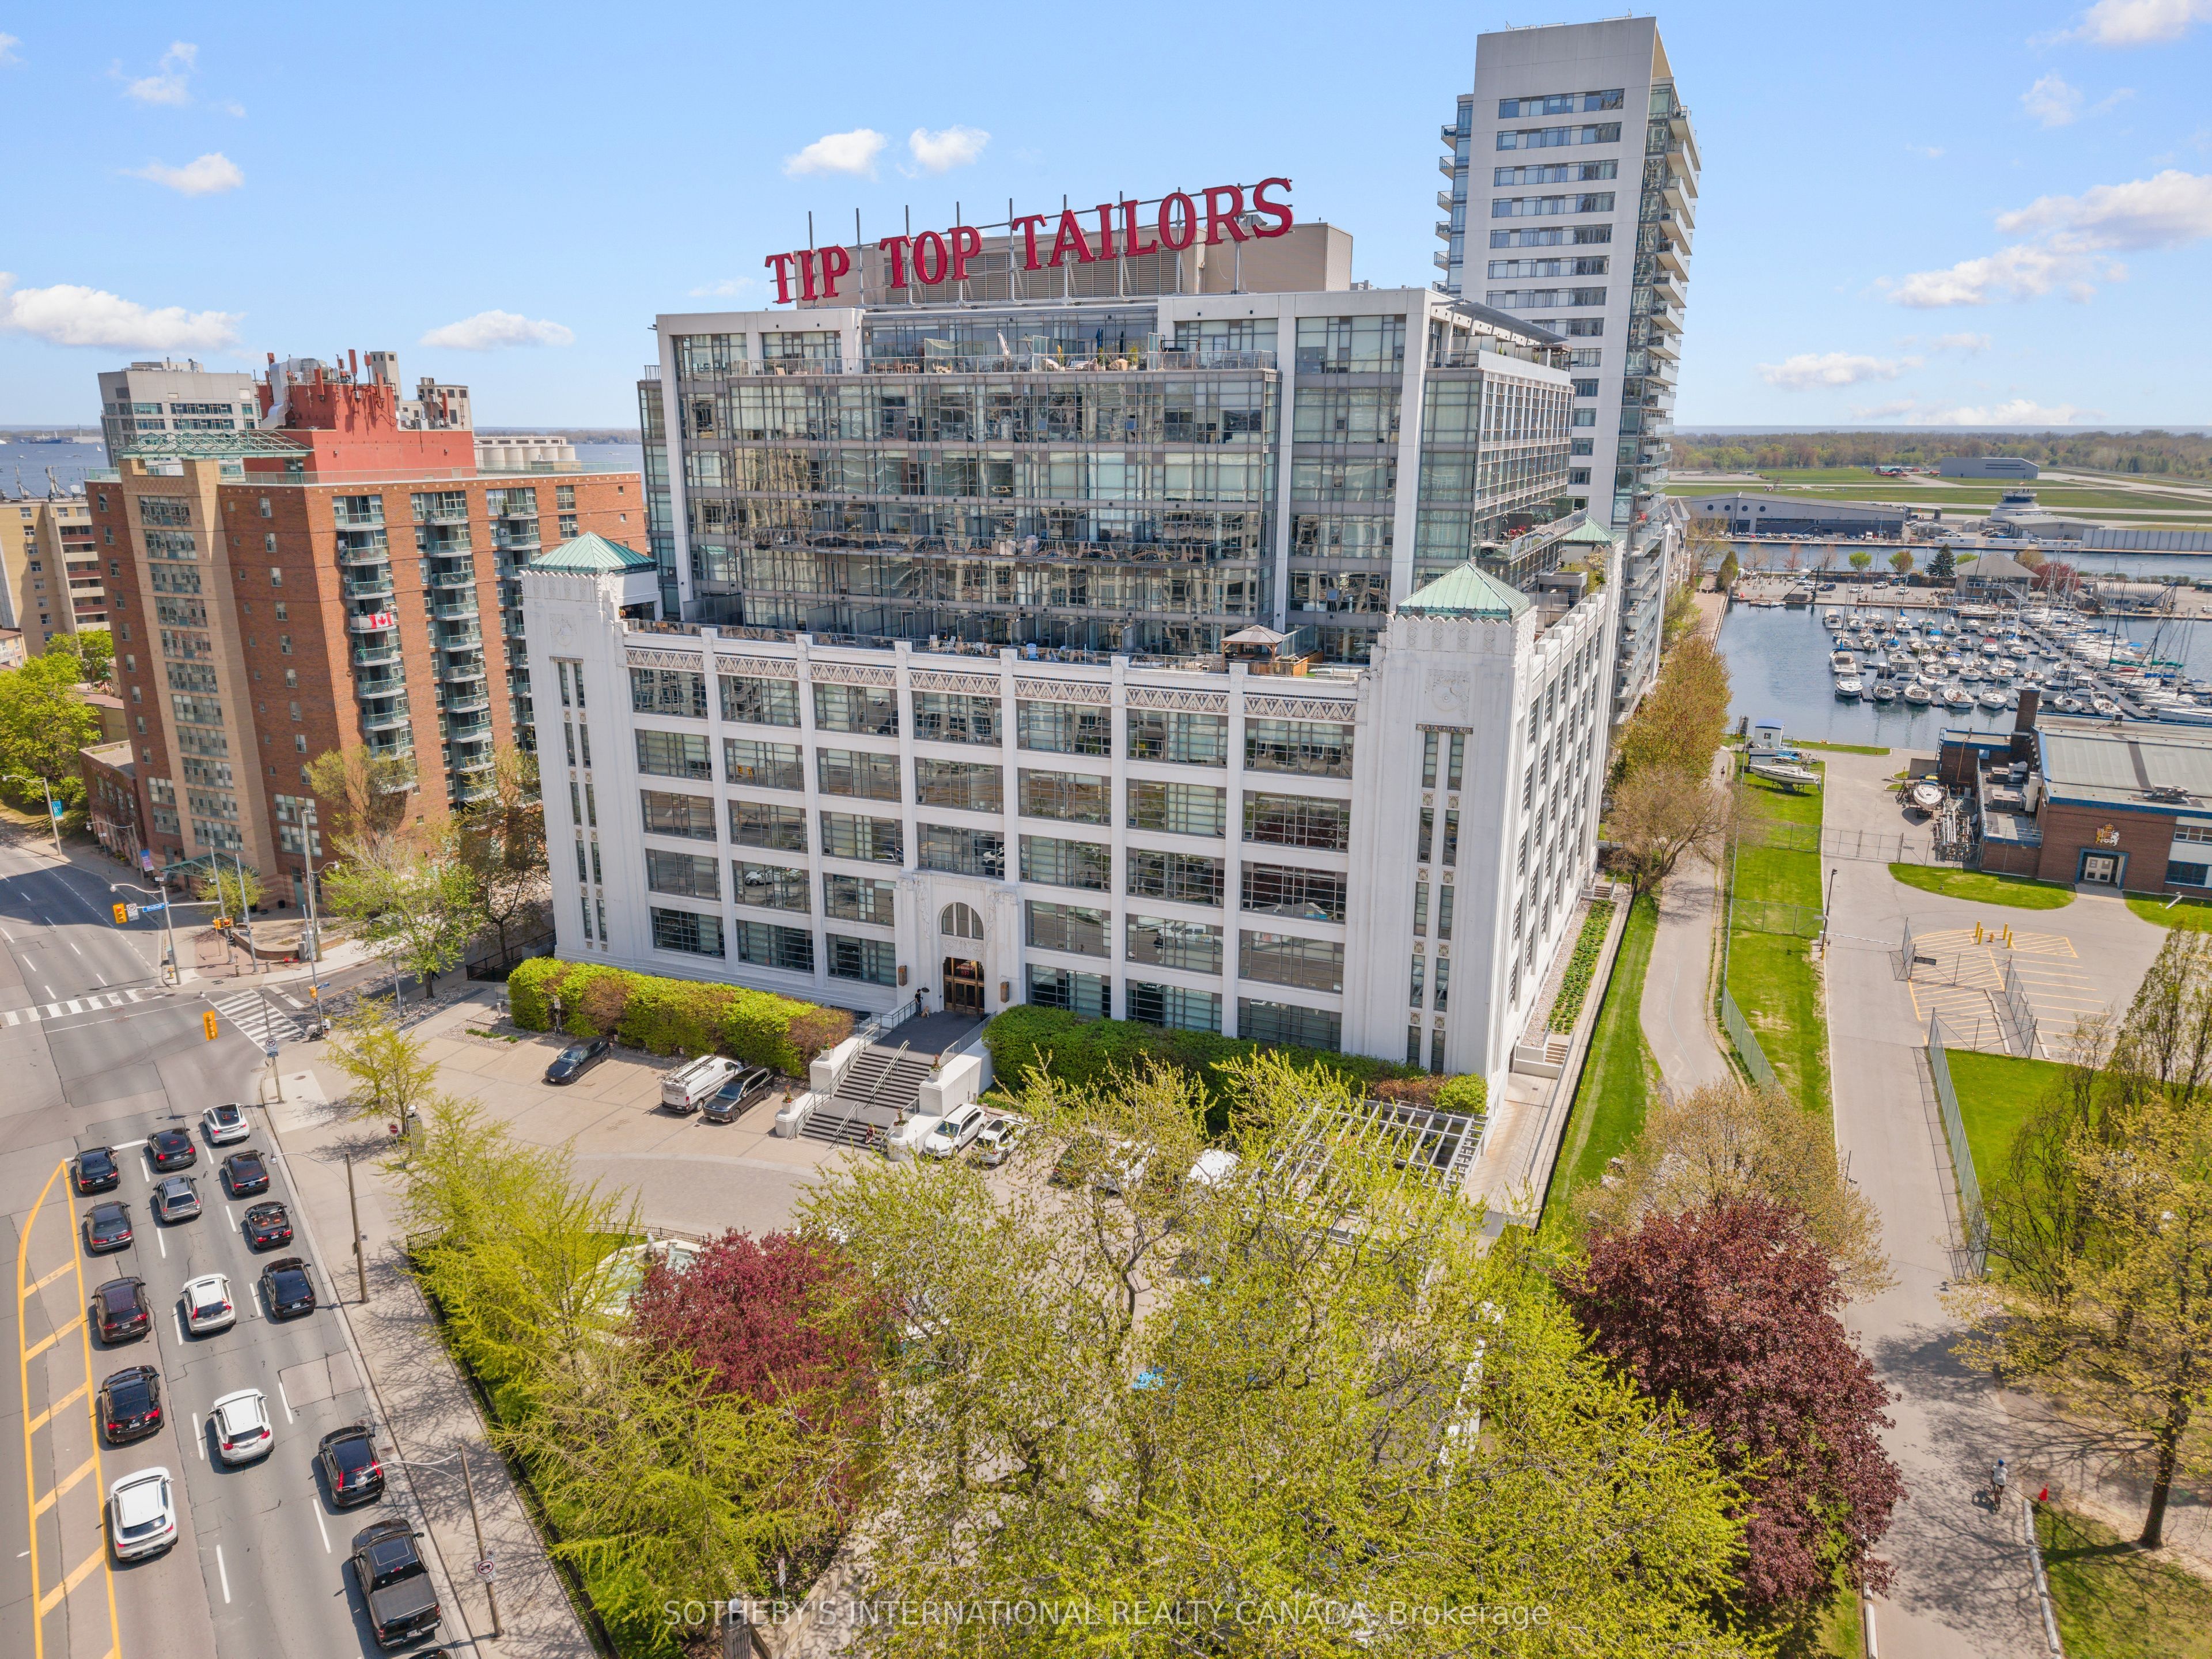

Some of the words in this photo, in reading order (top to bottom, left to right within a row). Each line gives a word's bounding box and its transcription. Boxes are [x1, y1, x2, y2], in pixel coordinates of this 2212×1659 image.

[764, 246, 850, 304] TIP
[879, 226, 982, 289] TOP
[1012, 177, 1294, 271] TAILORS
